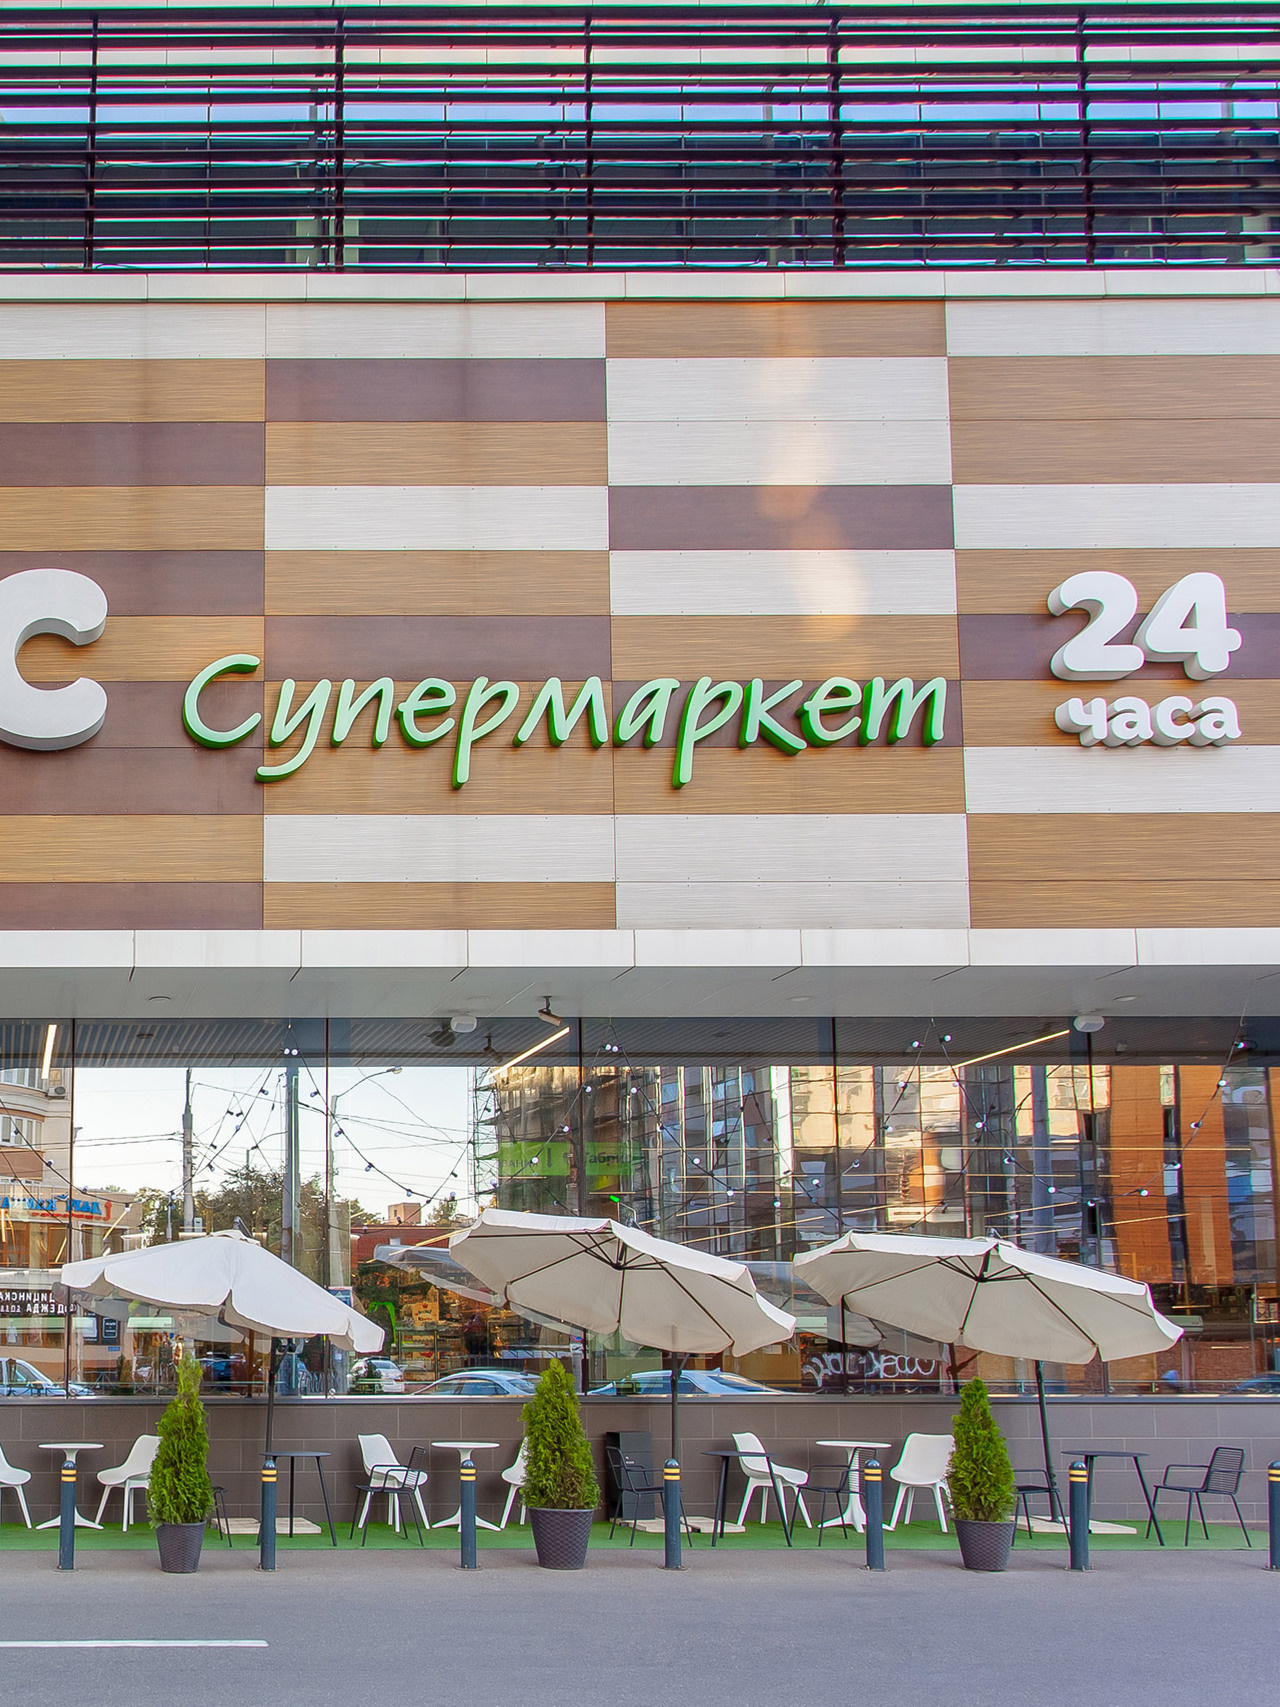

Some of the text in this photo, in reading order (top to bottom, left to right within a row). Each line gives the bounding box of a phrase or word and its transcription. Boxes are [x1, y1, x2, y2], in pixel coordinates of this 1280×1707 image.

[1048, 571, 1242, 681] 24
[183, 654, 949, 789] Супермаркет
[1055, 695, 1242, 748] часа
